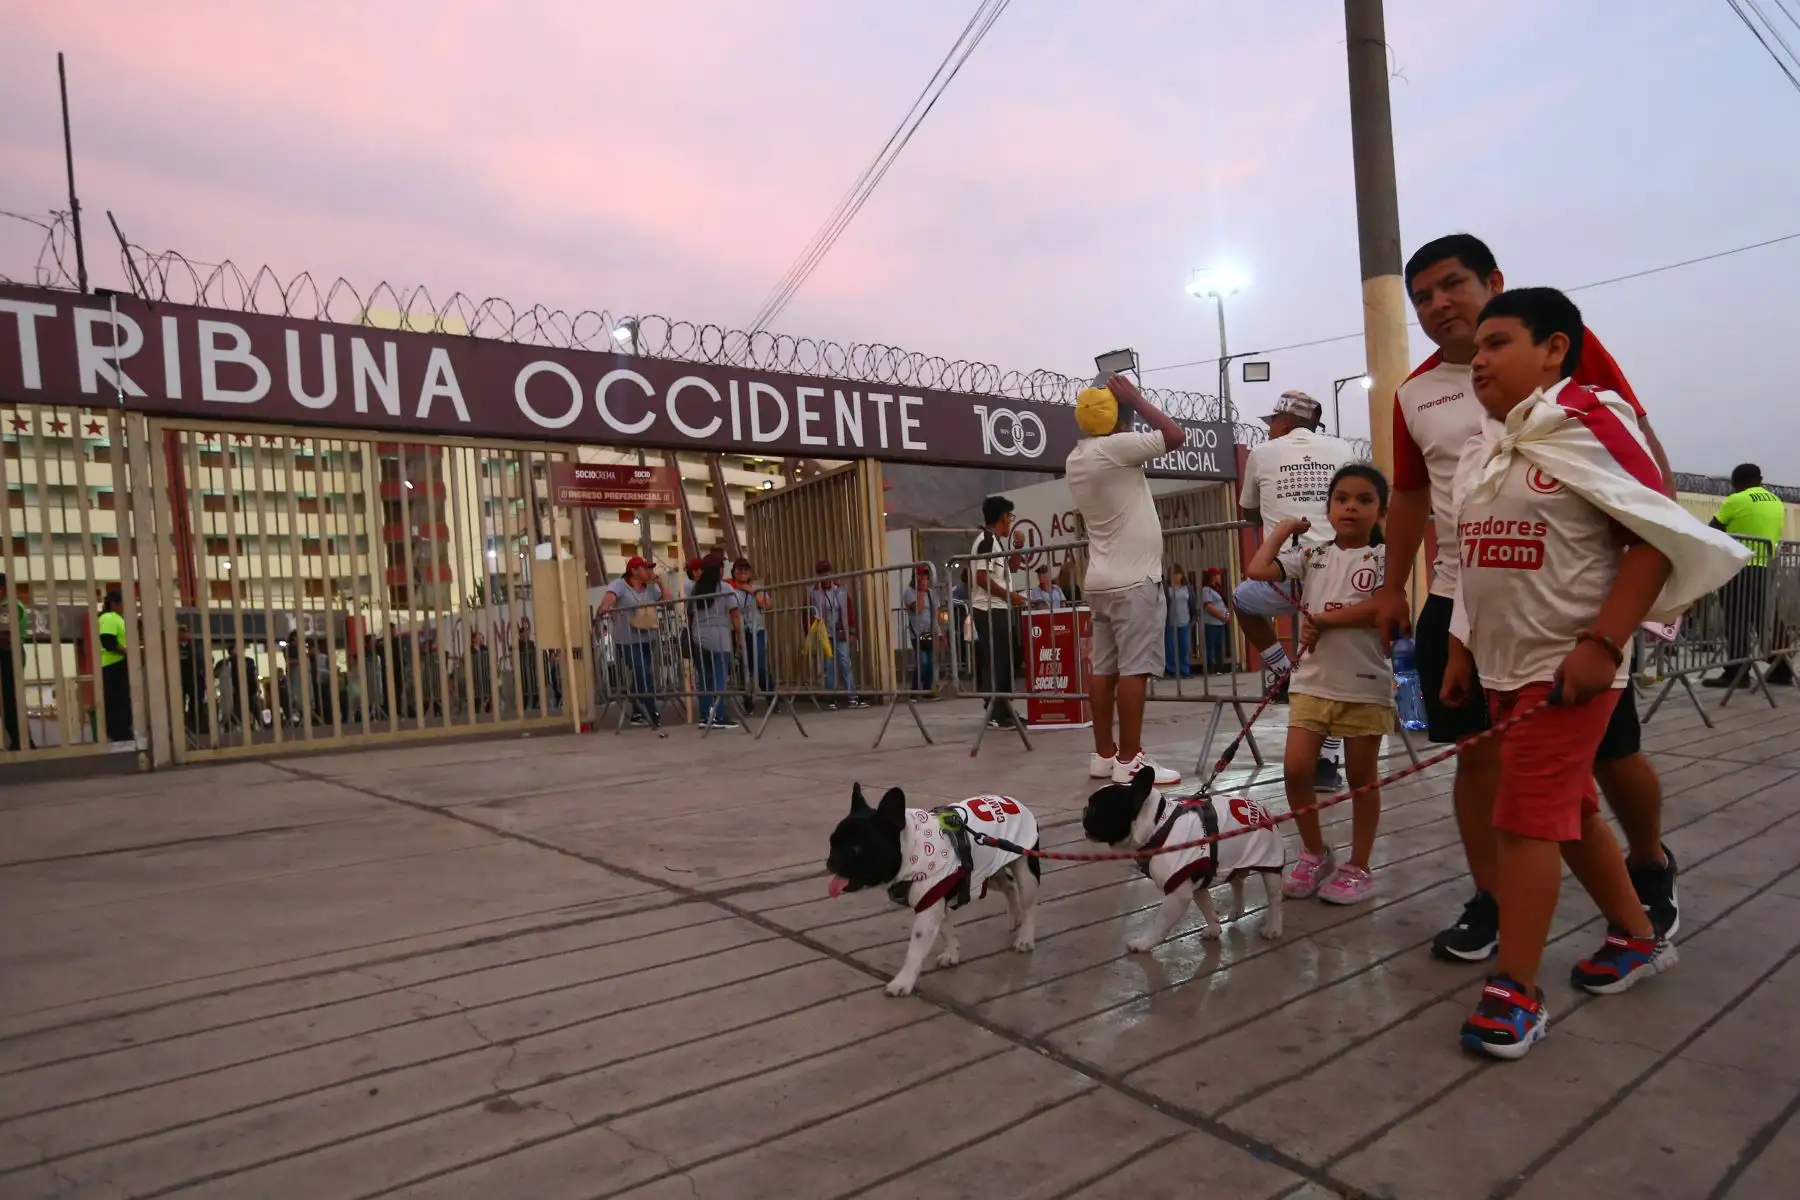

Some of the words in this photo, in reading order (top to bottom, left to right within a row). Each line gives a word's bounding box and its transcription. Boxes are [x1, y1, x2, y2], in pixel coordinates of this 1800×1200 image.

[0, 299, 472, 423] TRIBUNA
[514, 360, 928, 451] OCCIDENTE
[1417, 392, 1465, 412] marathon
[973, 404, 1047, 458] 100
[1179, 422, 1217, 448] PIDO
[1142, 450, 1220, 472] ERENCIAL
[1280, 461, 1336, 472] marathon
[568, 491, 602, 499] INGRESO
[604, 492, 662, 501] PREFERENCIAL
[1457, 516, 1547, 537] rcadores
[1459, 538, 1538, 568] 7.com
[1035, 676, 1068, 690] SOCIEAD
